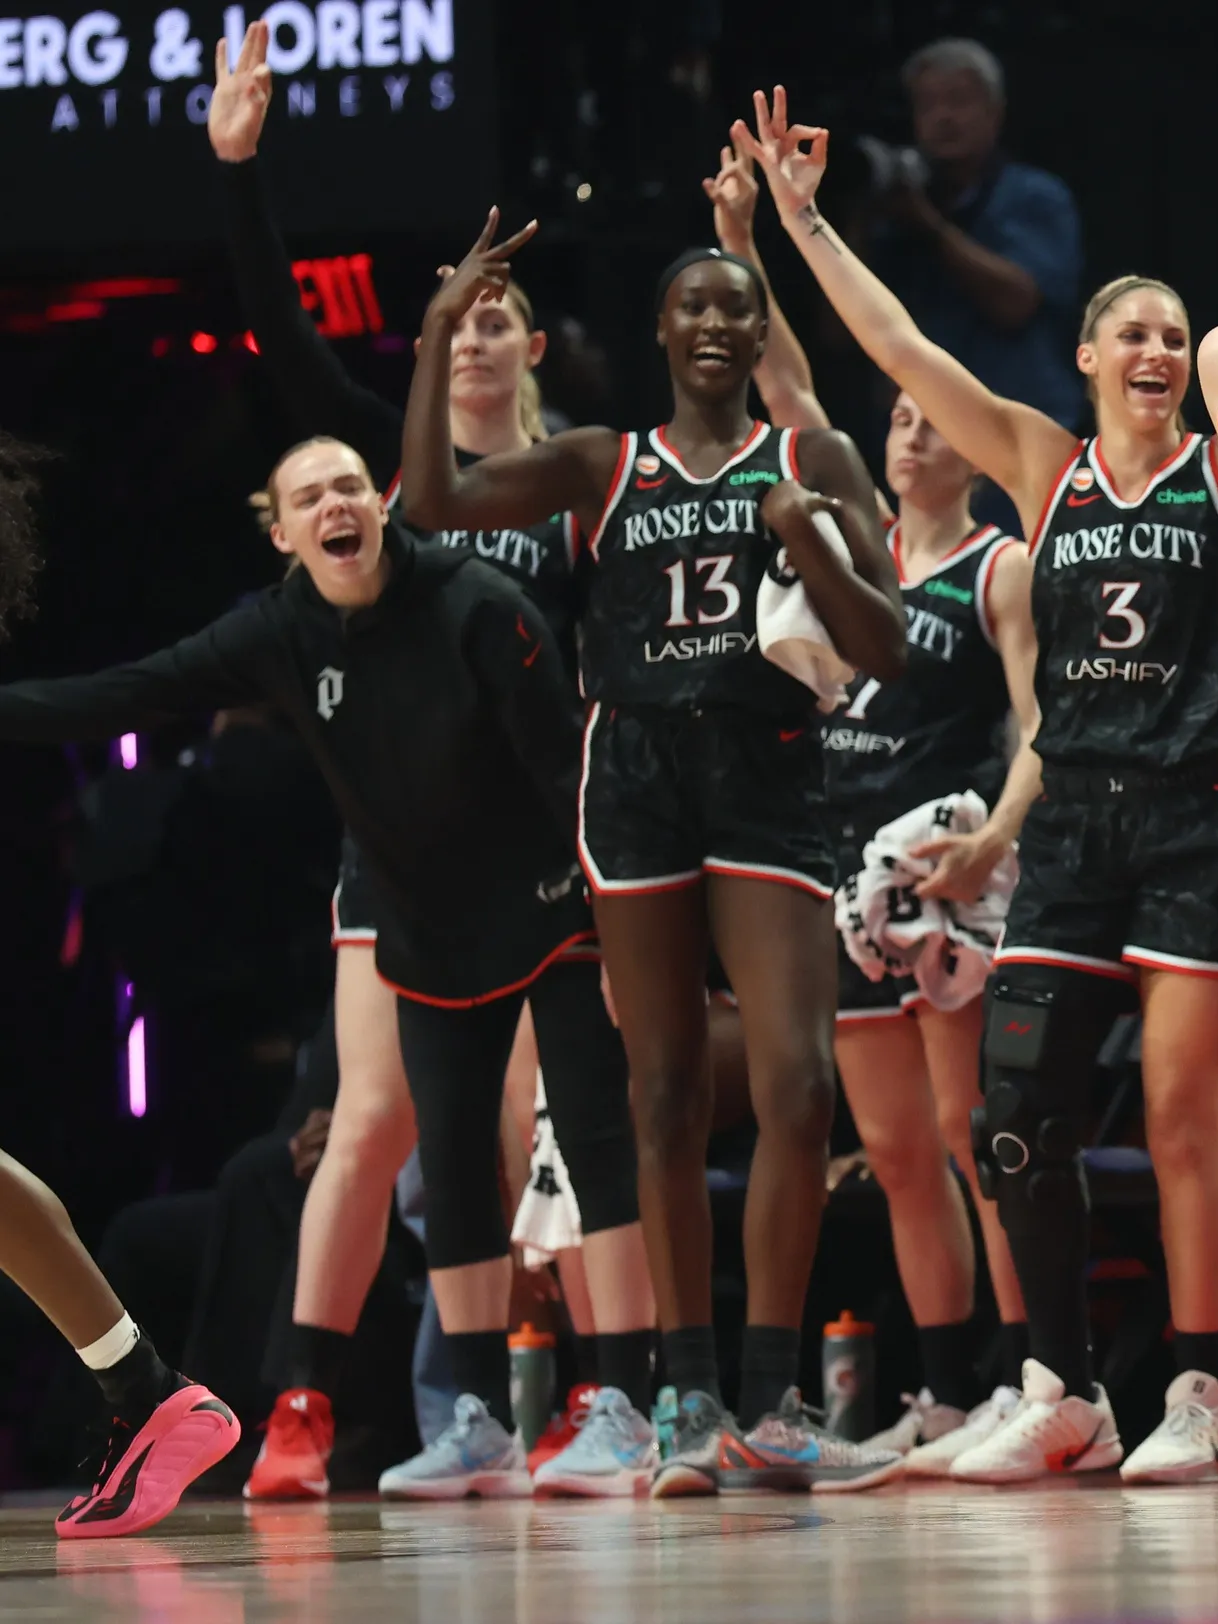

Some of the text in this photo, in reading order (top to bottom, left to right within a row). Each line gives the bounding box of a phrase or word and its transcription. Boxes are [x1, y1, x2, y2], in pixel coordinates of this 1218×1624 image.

[0, 9, 129, 88] ERG
[149, 7, 203, 81] &
[52, 71, 455, 132] ATTONEYS
[729, 470, 779, 486] chime
[624, 499, 771, 551] ROSE CIT
[1052, 523, 1207, 569] ROSE CITY
[663, 553, 741, 627] 13
[1099, 582, 1146, 649] 3
[644, 632, 757, 663] LASHIFY
[1066, 658, 1178, 684] LASHIFY
